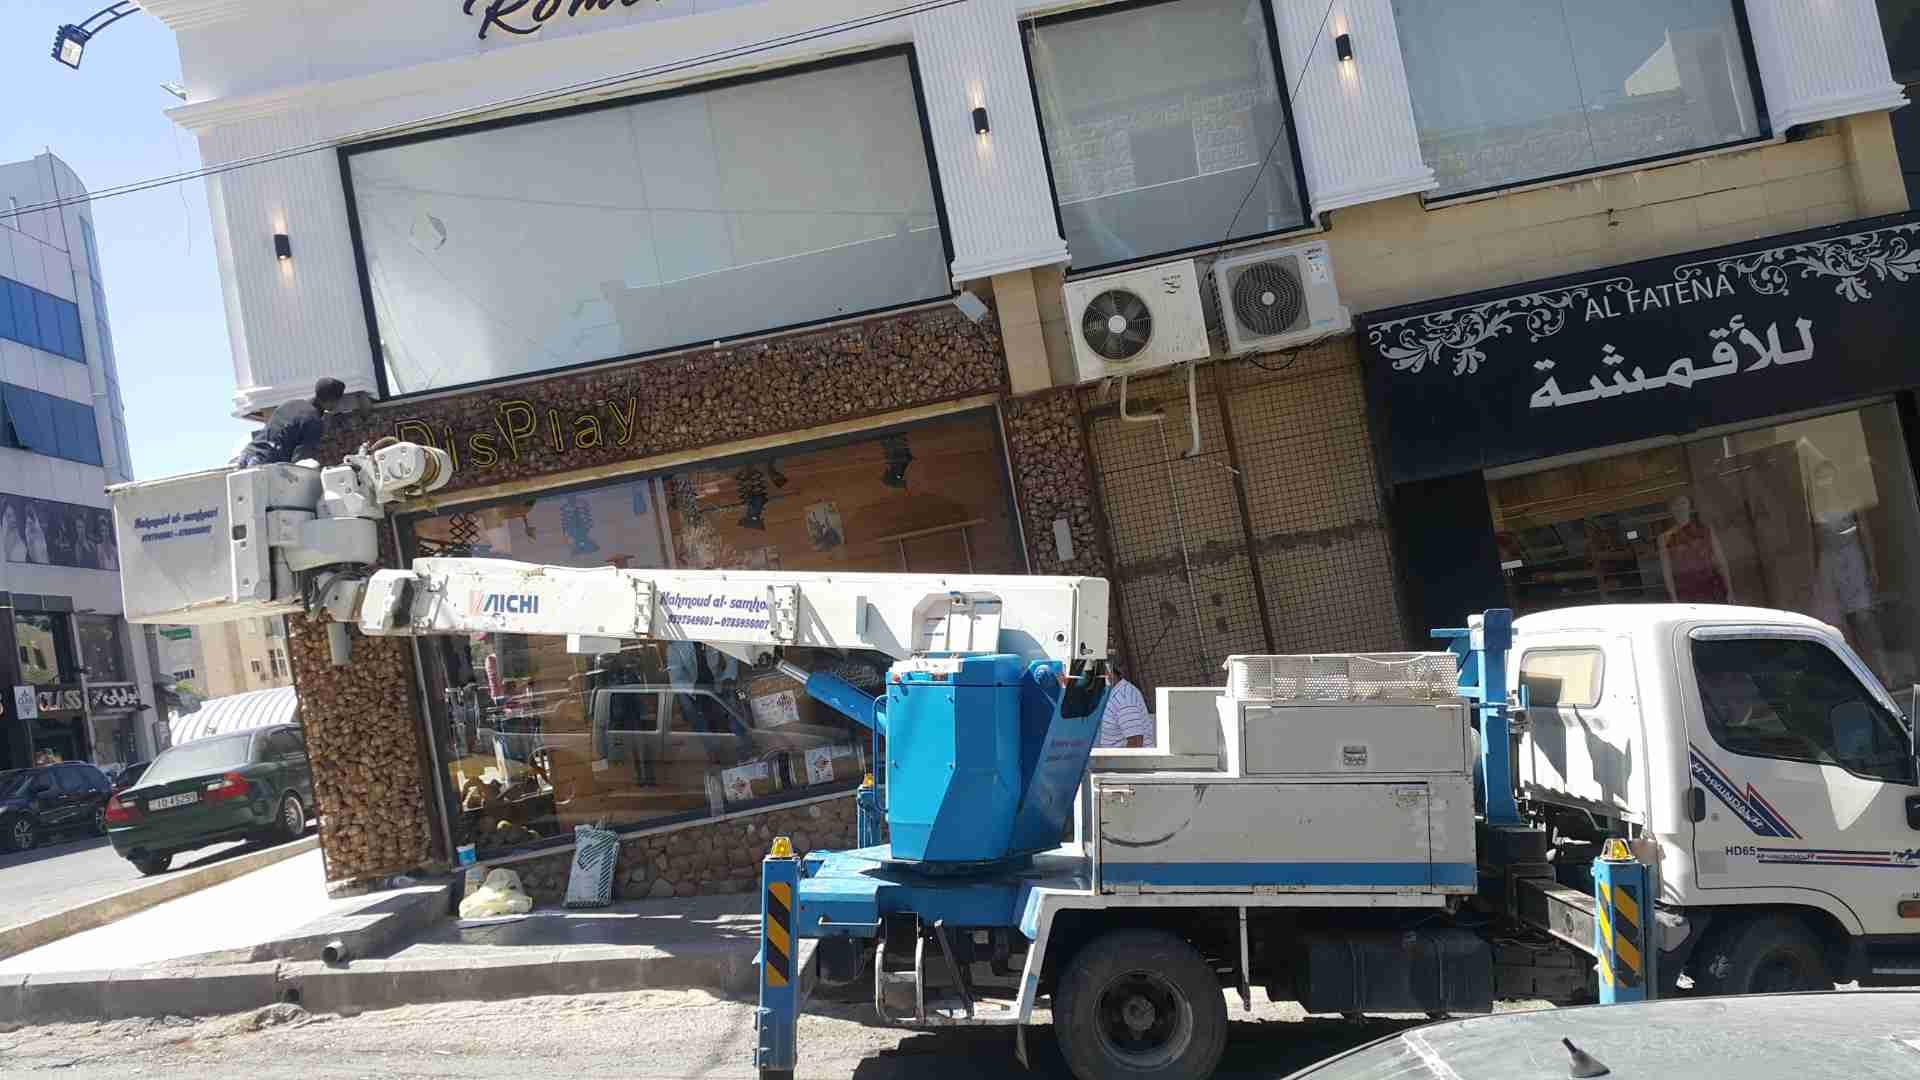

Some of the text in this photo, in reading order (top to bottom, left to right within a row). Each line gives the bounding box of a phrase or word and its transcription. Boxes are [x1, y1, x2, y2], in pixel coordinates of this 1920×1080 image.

[1584, 273, 1737, 322] AL FATENA
[1528, 313, 1816, 408] للأقمشة
[483, 593, 539, 614] AICHI
[1725, 846, 1757, 857] HD65
